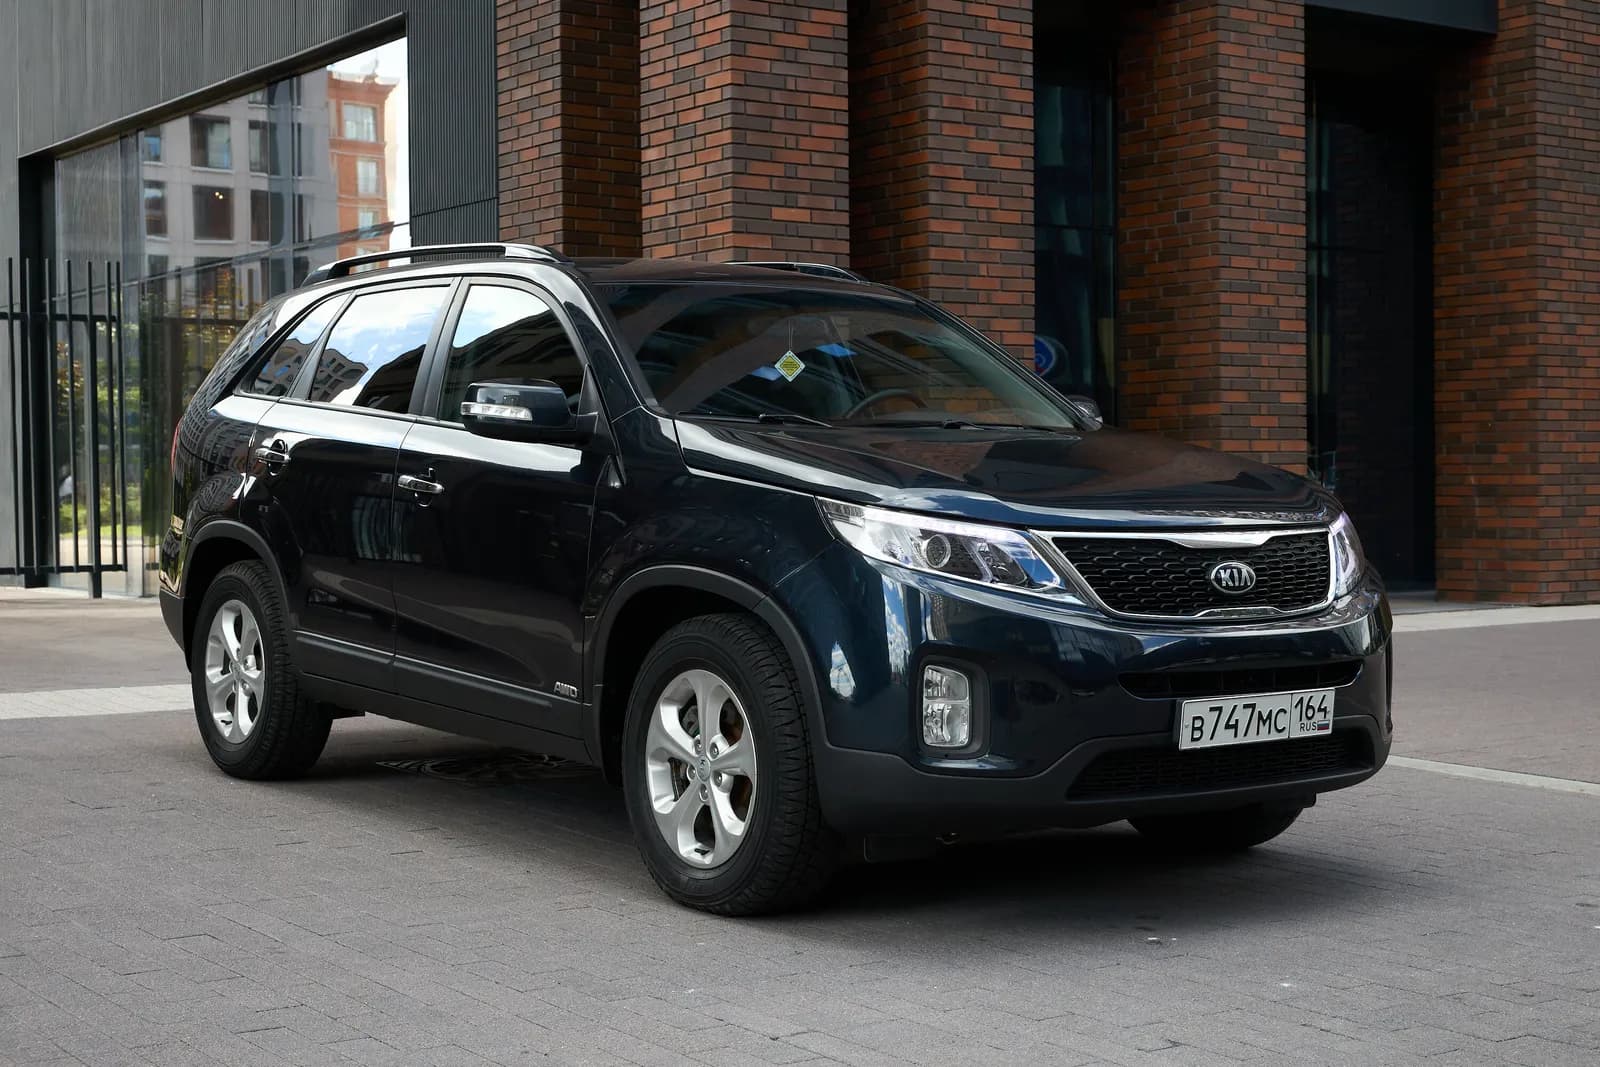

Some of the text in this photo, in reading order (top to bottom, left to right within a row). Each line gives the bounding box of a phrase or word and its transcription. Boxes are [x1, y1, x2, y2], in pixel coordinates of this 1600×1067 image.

[1219, 568, 1251, 587] KIA
[1294, 694, 1329, 723] 164
[1300, 721, 1317, 732] RUS
